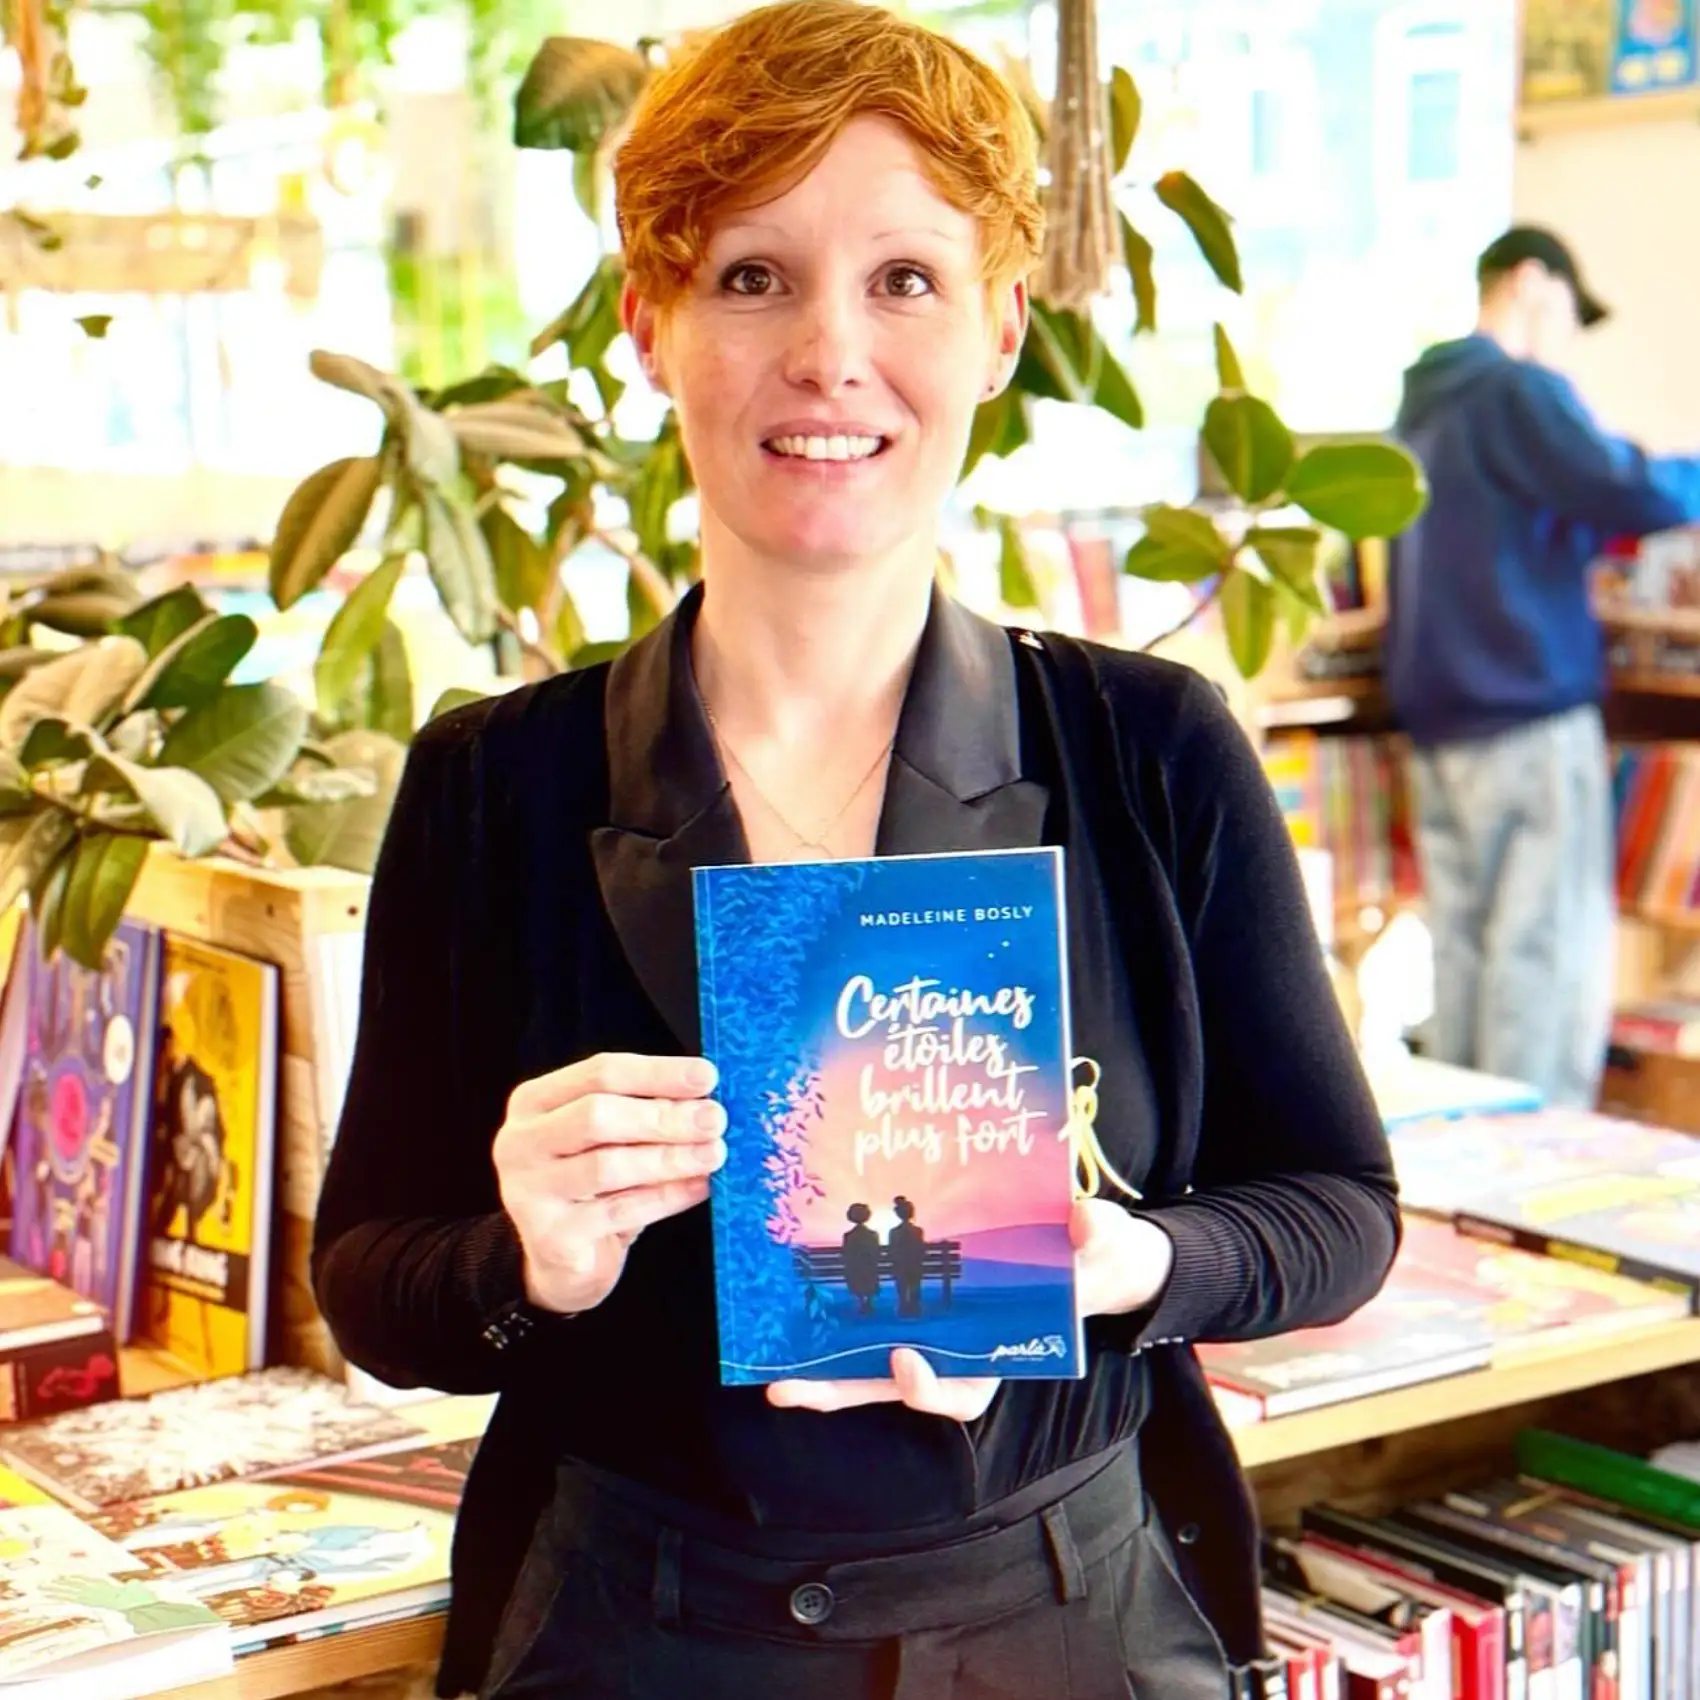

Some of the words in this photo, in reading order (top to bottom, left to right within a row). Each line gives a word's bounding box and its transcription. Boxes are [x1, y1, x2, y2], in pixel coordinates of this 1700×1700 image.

[860, 908, 968, 927] MADELEINE
[974, 905, 1034, 921] BOSLY
[836, 974, 1036, 1039] Certaines
[883, 1016, 1008, 1079] étoiles
[859, 1059, 1040, 1117] brillent
[854, 1110, 943, 1177] plus
[956, 1107, 1048, 1167] fort
